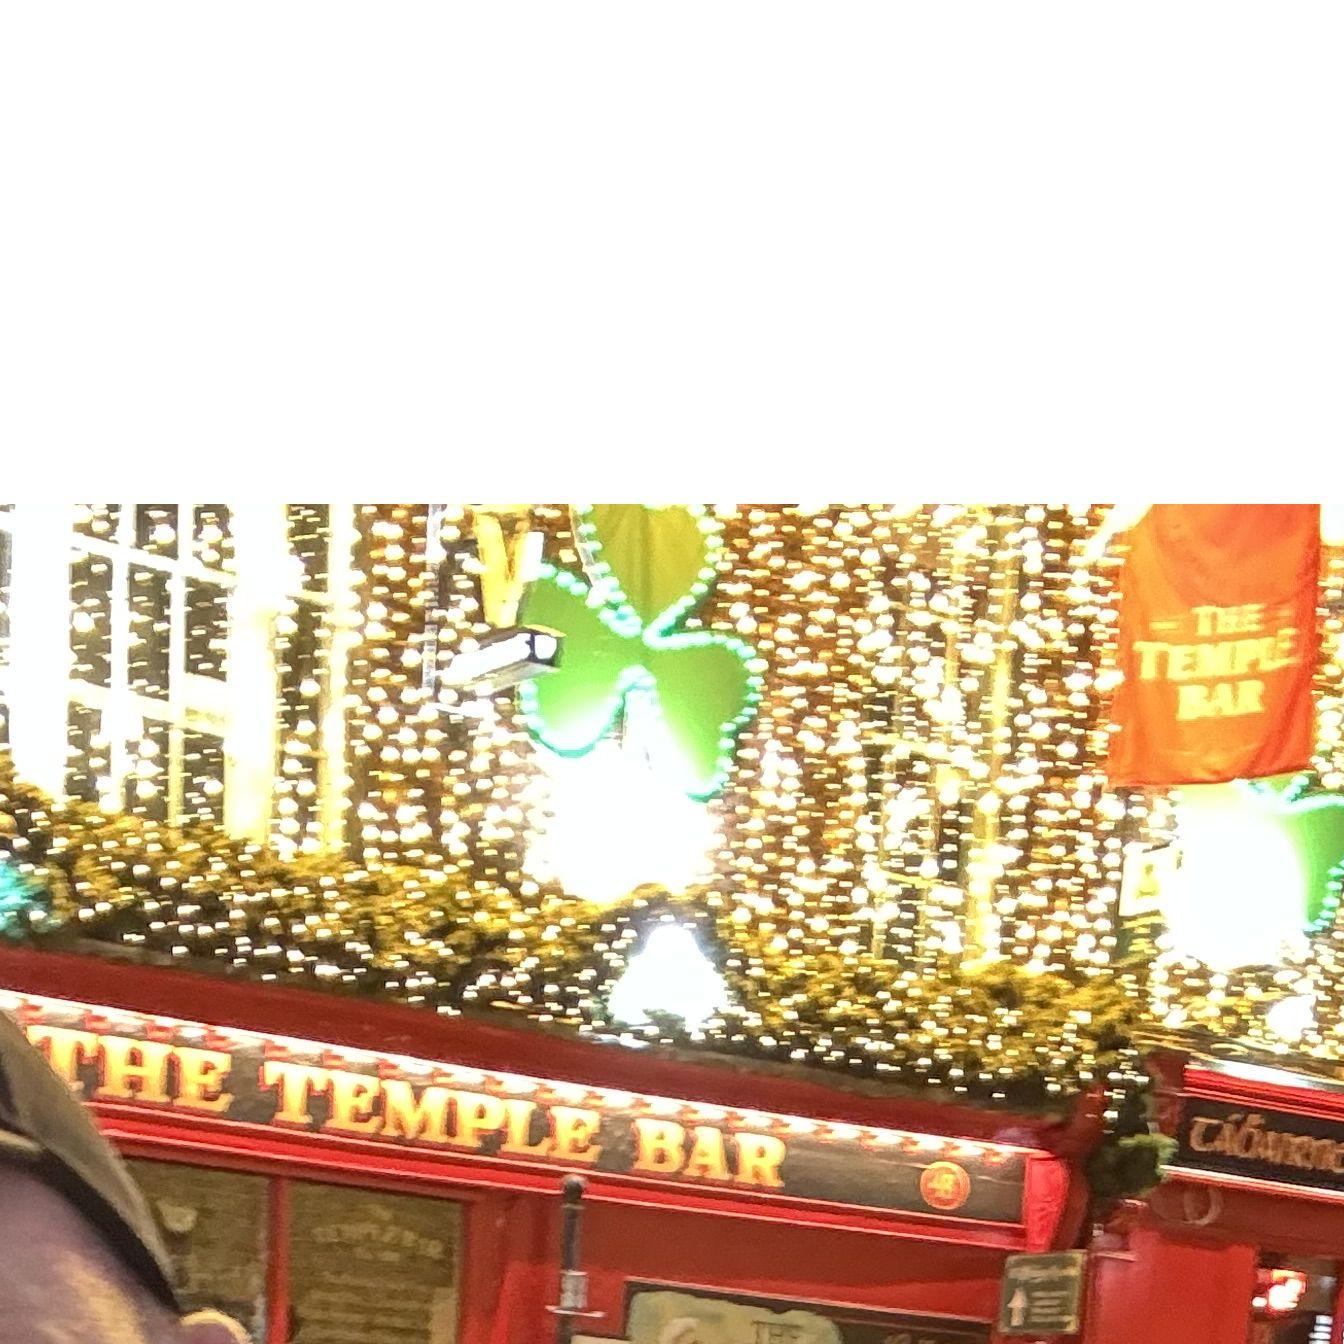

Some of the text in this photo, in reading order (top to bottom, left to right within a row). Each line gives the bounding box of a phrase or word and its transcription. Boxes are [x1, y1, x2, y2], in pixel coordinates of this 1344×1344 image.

[1190, 602, 1268, 637] THE
[1132, 627, 1301, 682] TEMPLE
[1175, 679, 1266, 722] BAR
[25, 1023, 787, 1189] THE TEMPLE BAR
